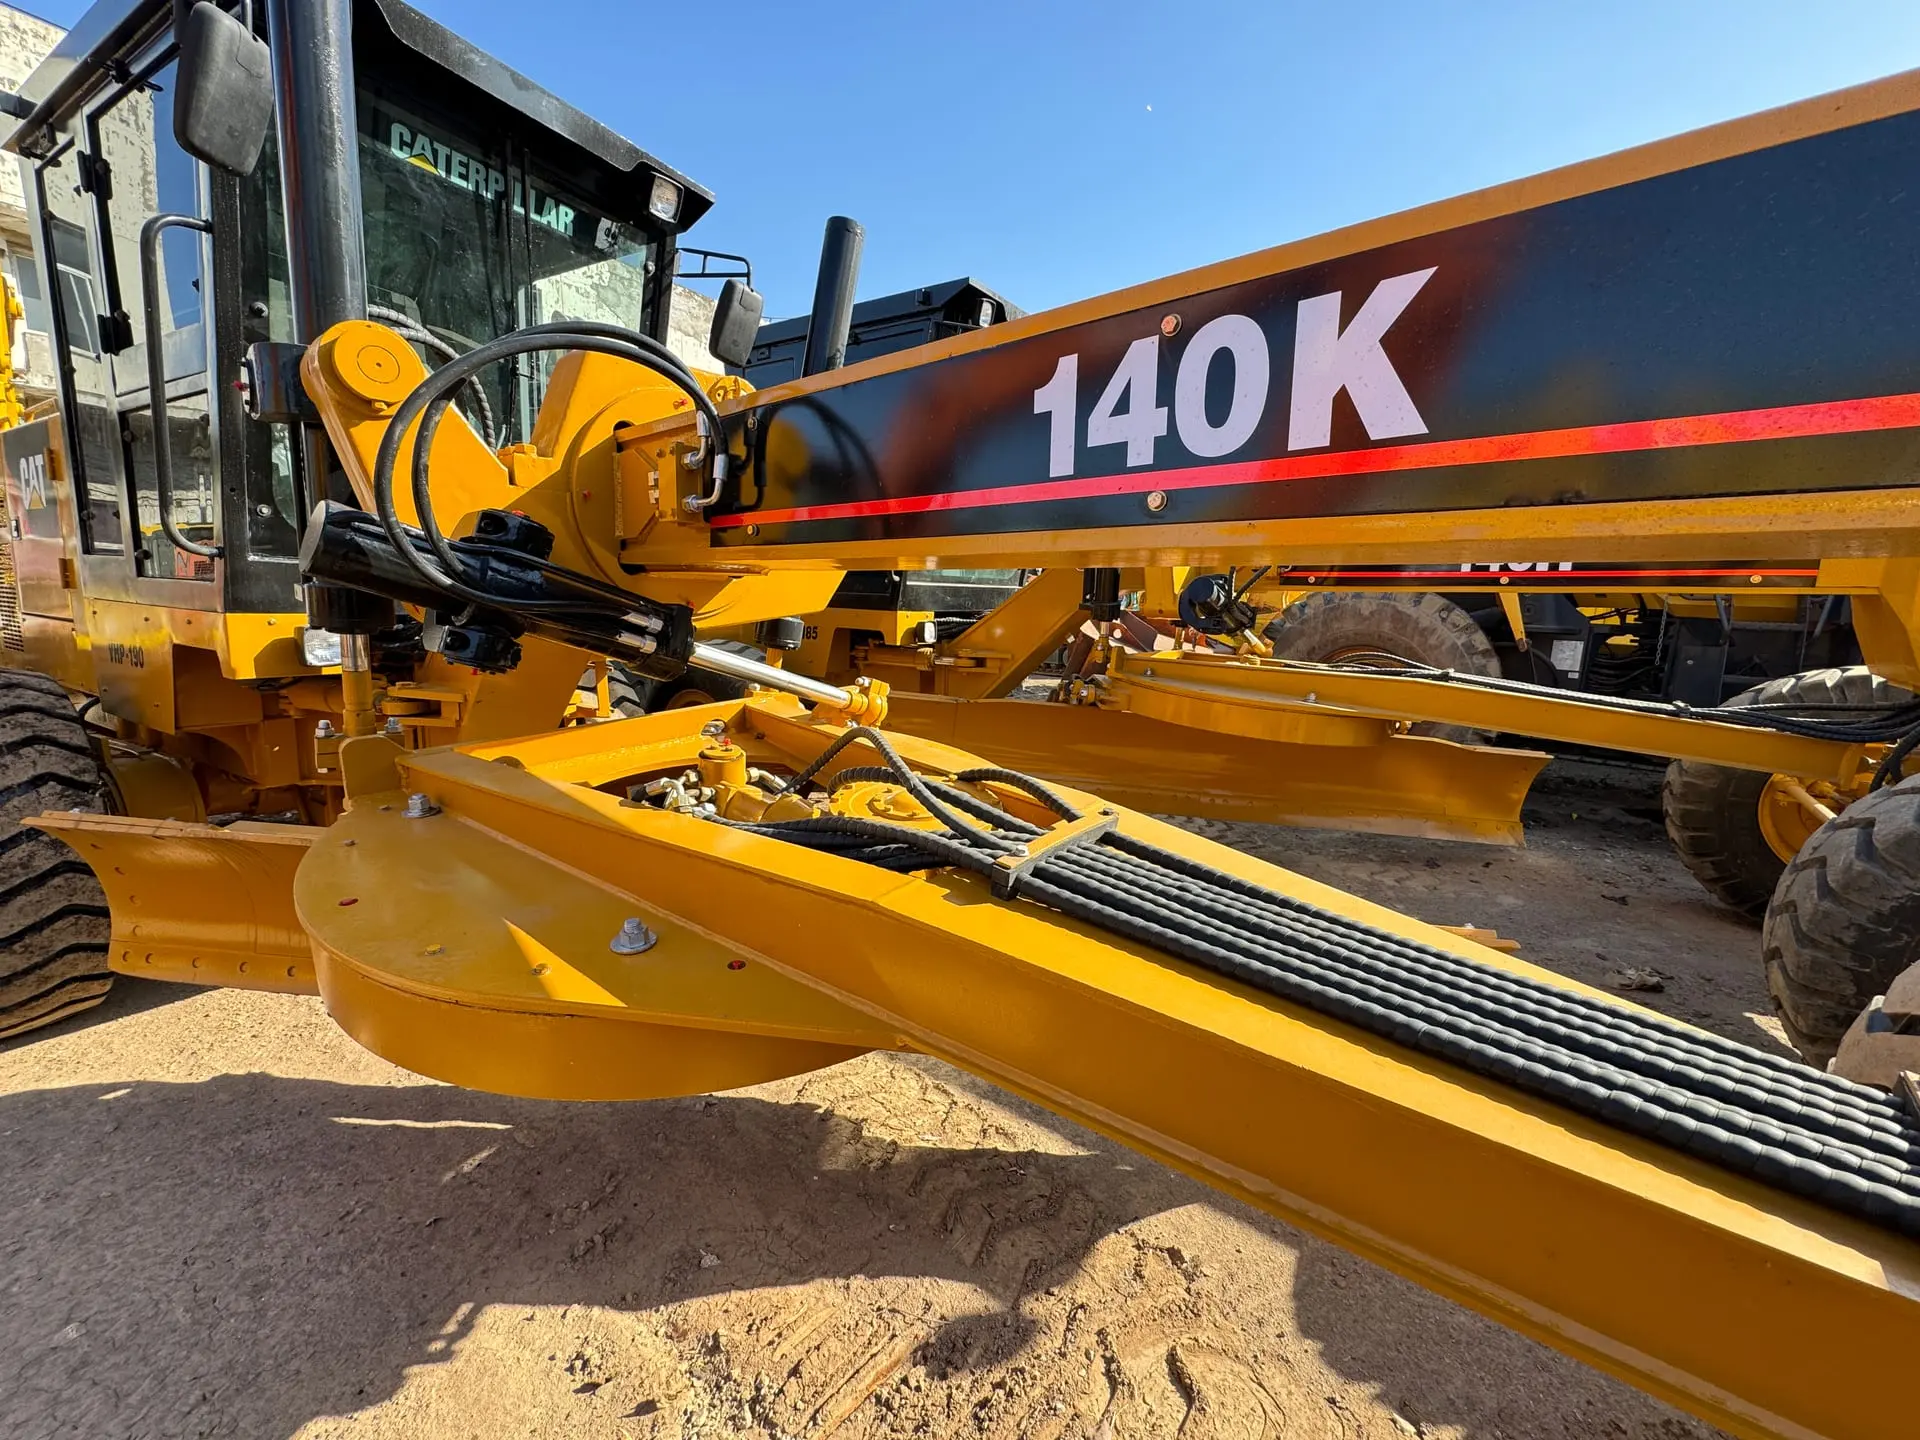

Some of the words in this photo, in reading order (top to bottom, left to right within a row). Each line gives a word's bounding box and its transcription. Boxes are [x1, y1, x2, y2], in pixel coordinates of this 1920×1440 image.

[391, 122, 574, 237] CATERPLLAR
[1034, 266, 1438, 478] 140K
[20, 454, 46, 510] CAT
